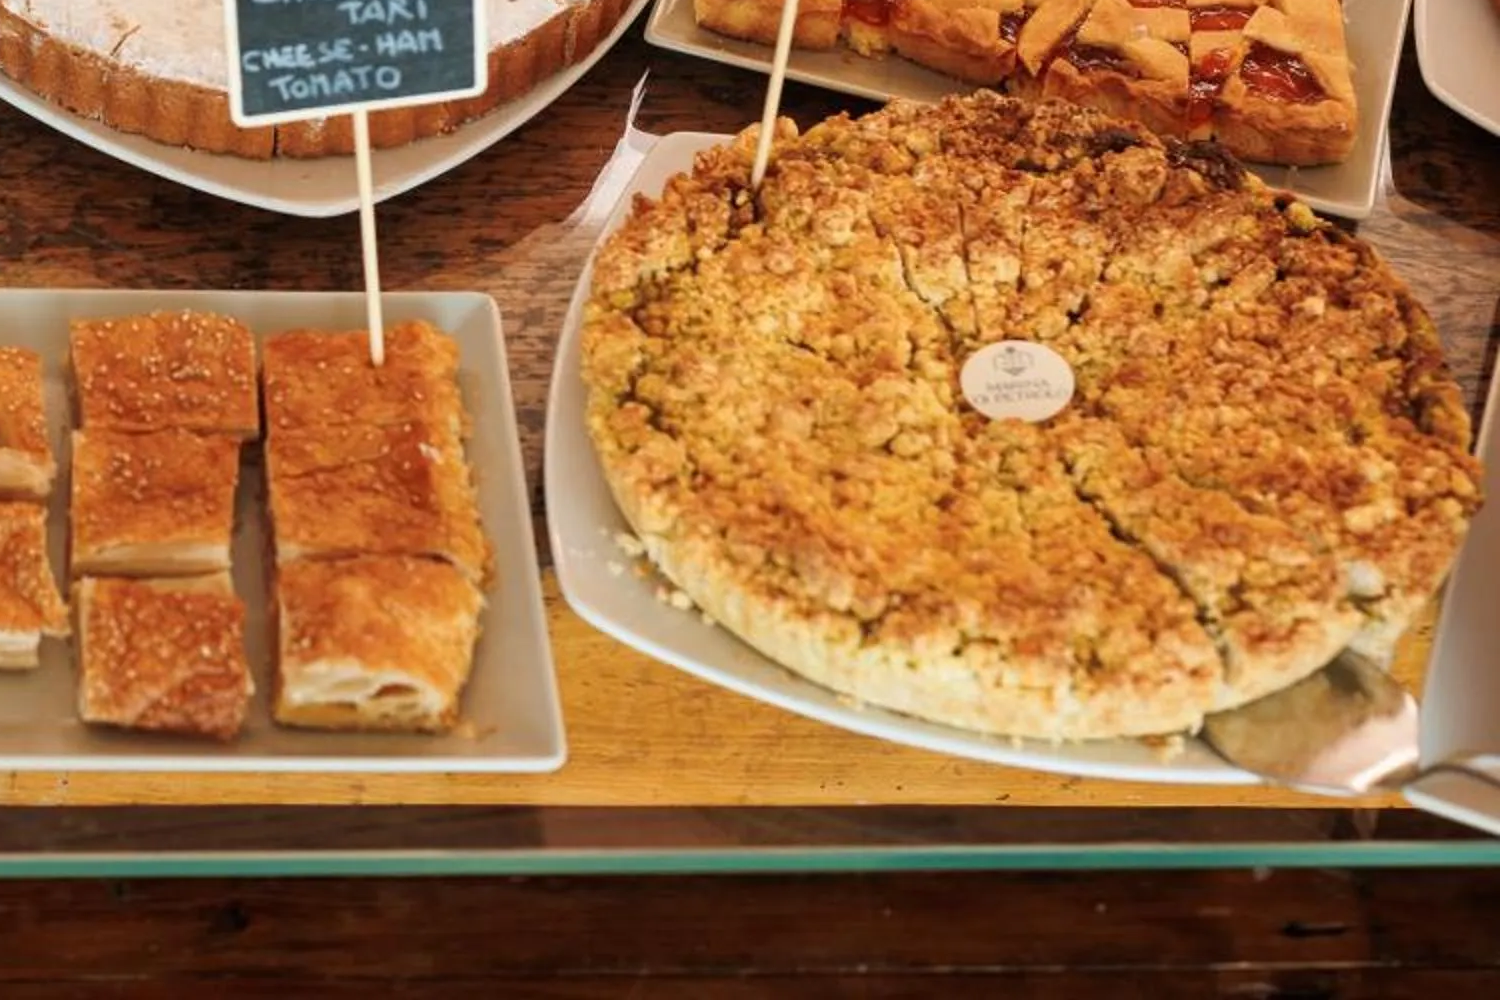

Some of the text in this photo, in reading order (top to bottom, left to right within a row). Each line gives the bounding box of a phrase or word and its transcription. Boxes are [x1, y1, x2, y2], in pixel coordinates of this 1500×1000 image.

[242, 37, 354, 73] CHEESE
[375, 26, 444, 57] HAM
[268, 65, 402, 102] TOMATO
